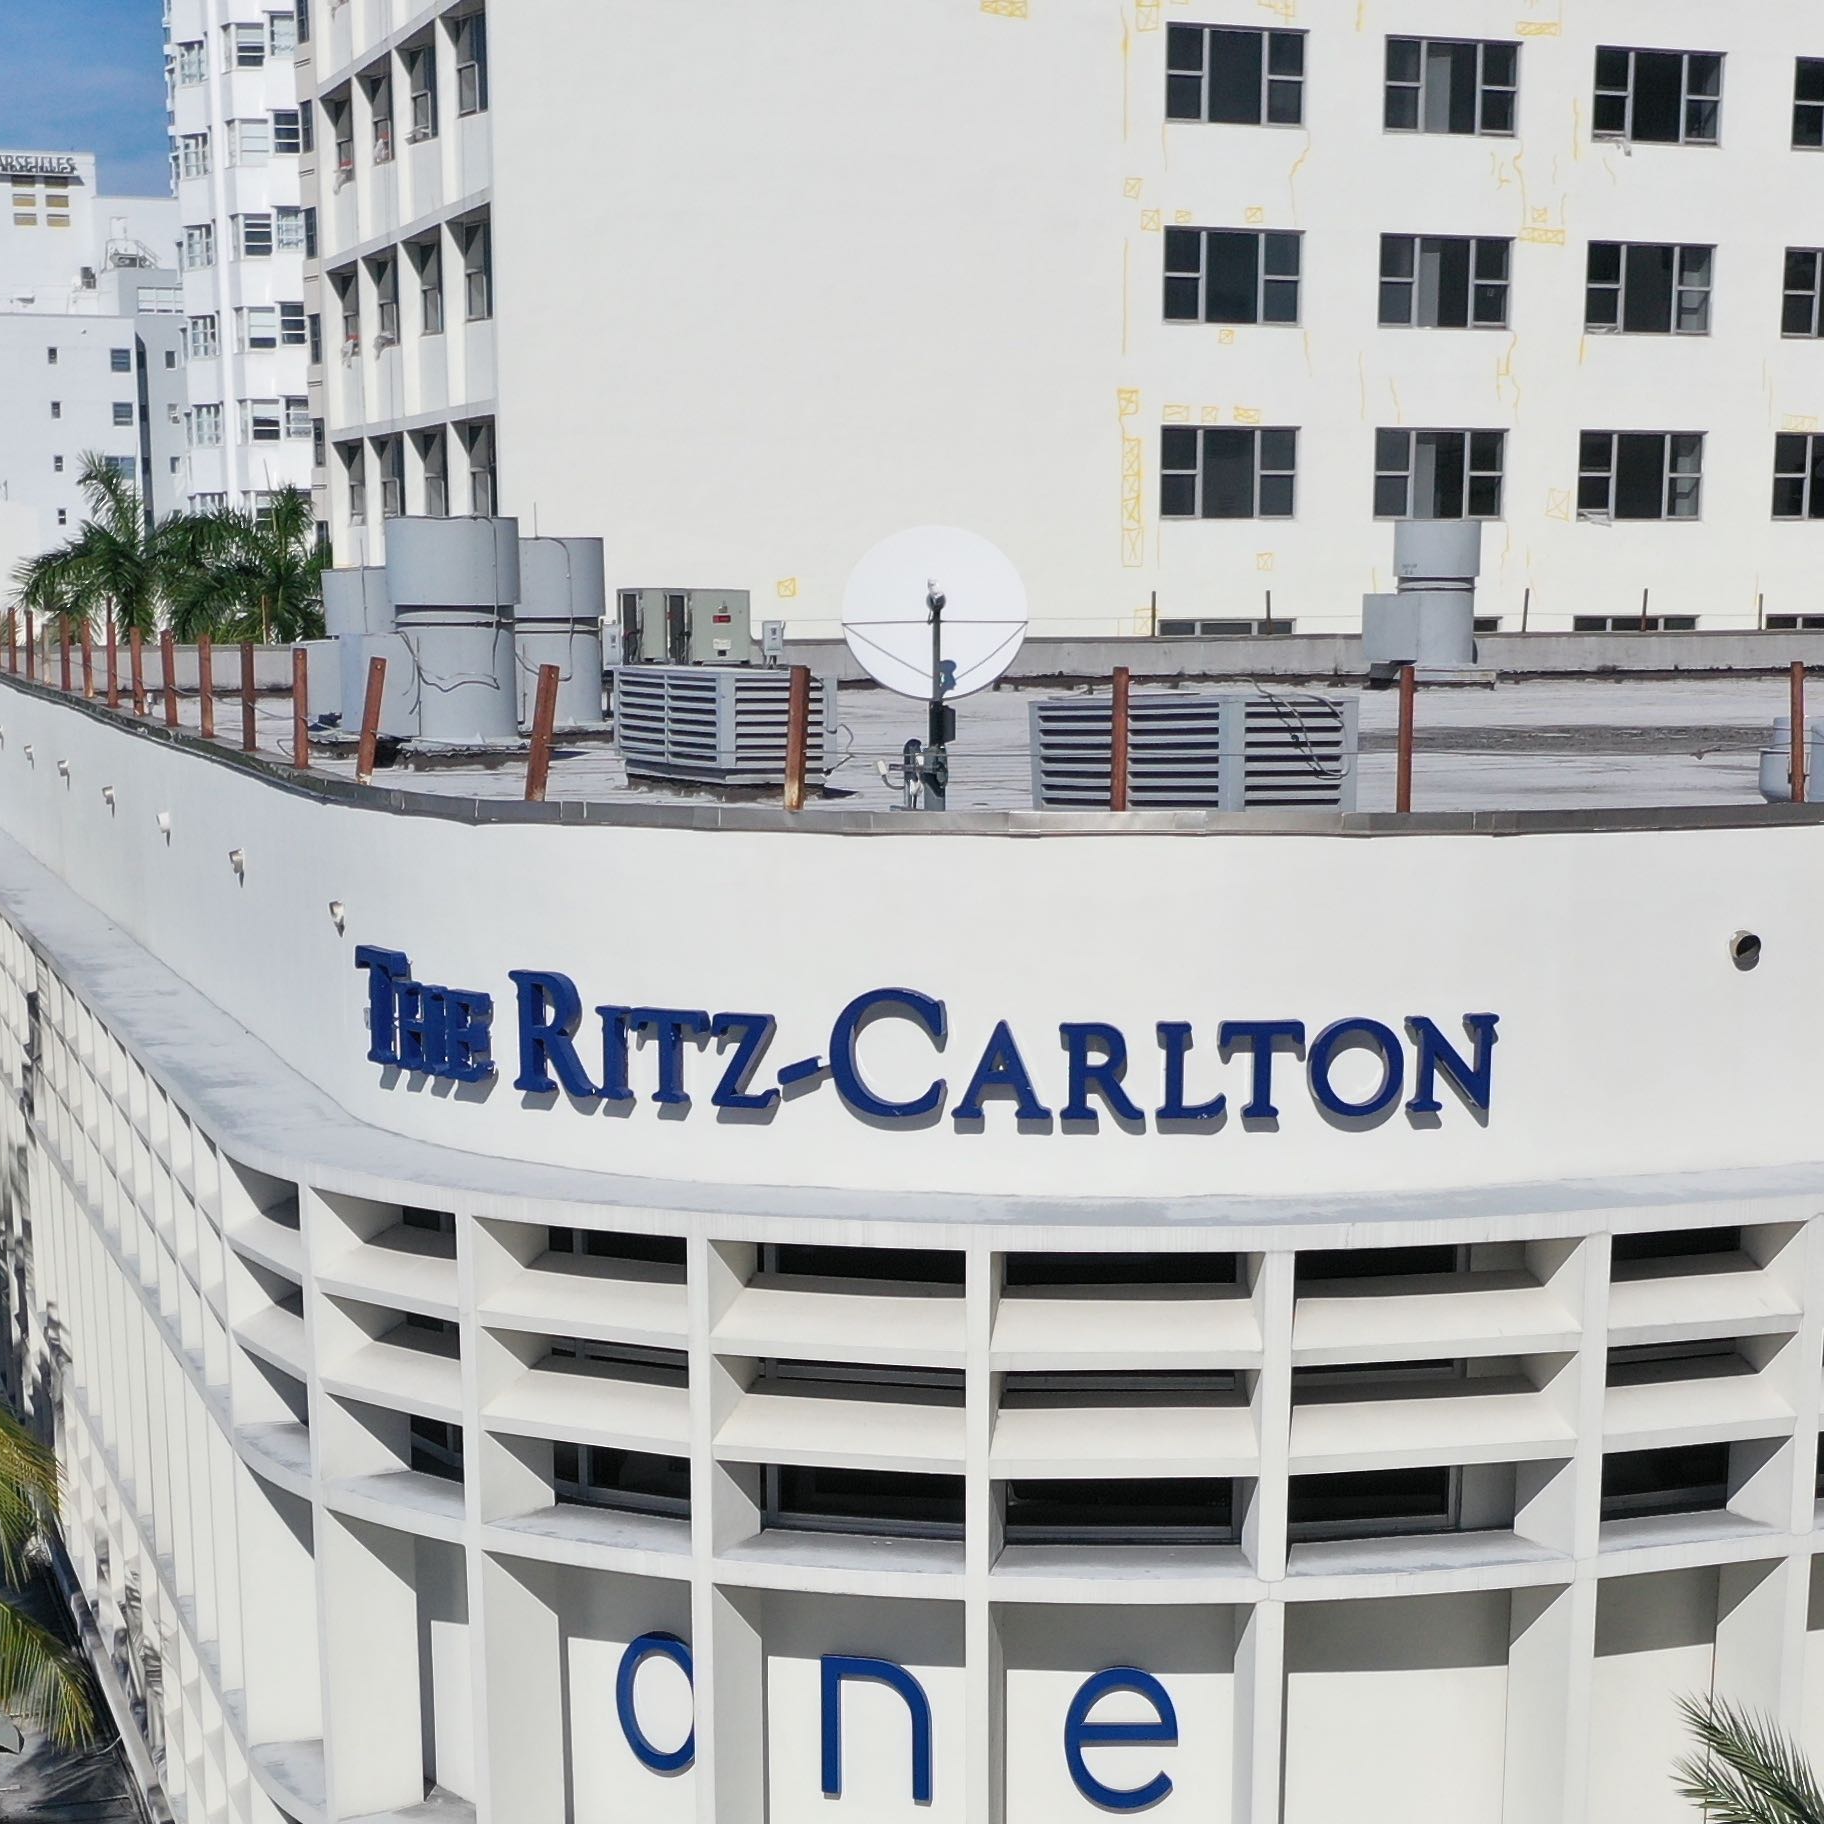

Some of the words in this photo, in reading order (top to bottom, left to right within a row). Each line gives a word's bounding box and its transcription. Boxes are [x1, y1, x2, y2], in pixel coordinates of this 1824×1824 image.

[356, 945, 494, 1083] THE
[509, 970, 1499, 1121] RITZ-CARLTON
[616, 1630, 1180, 1810] one
